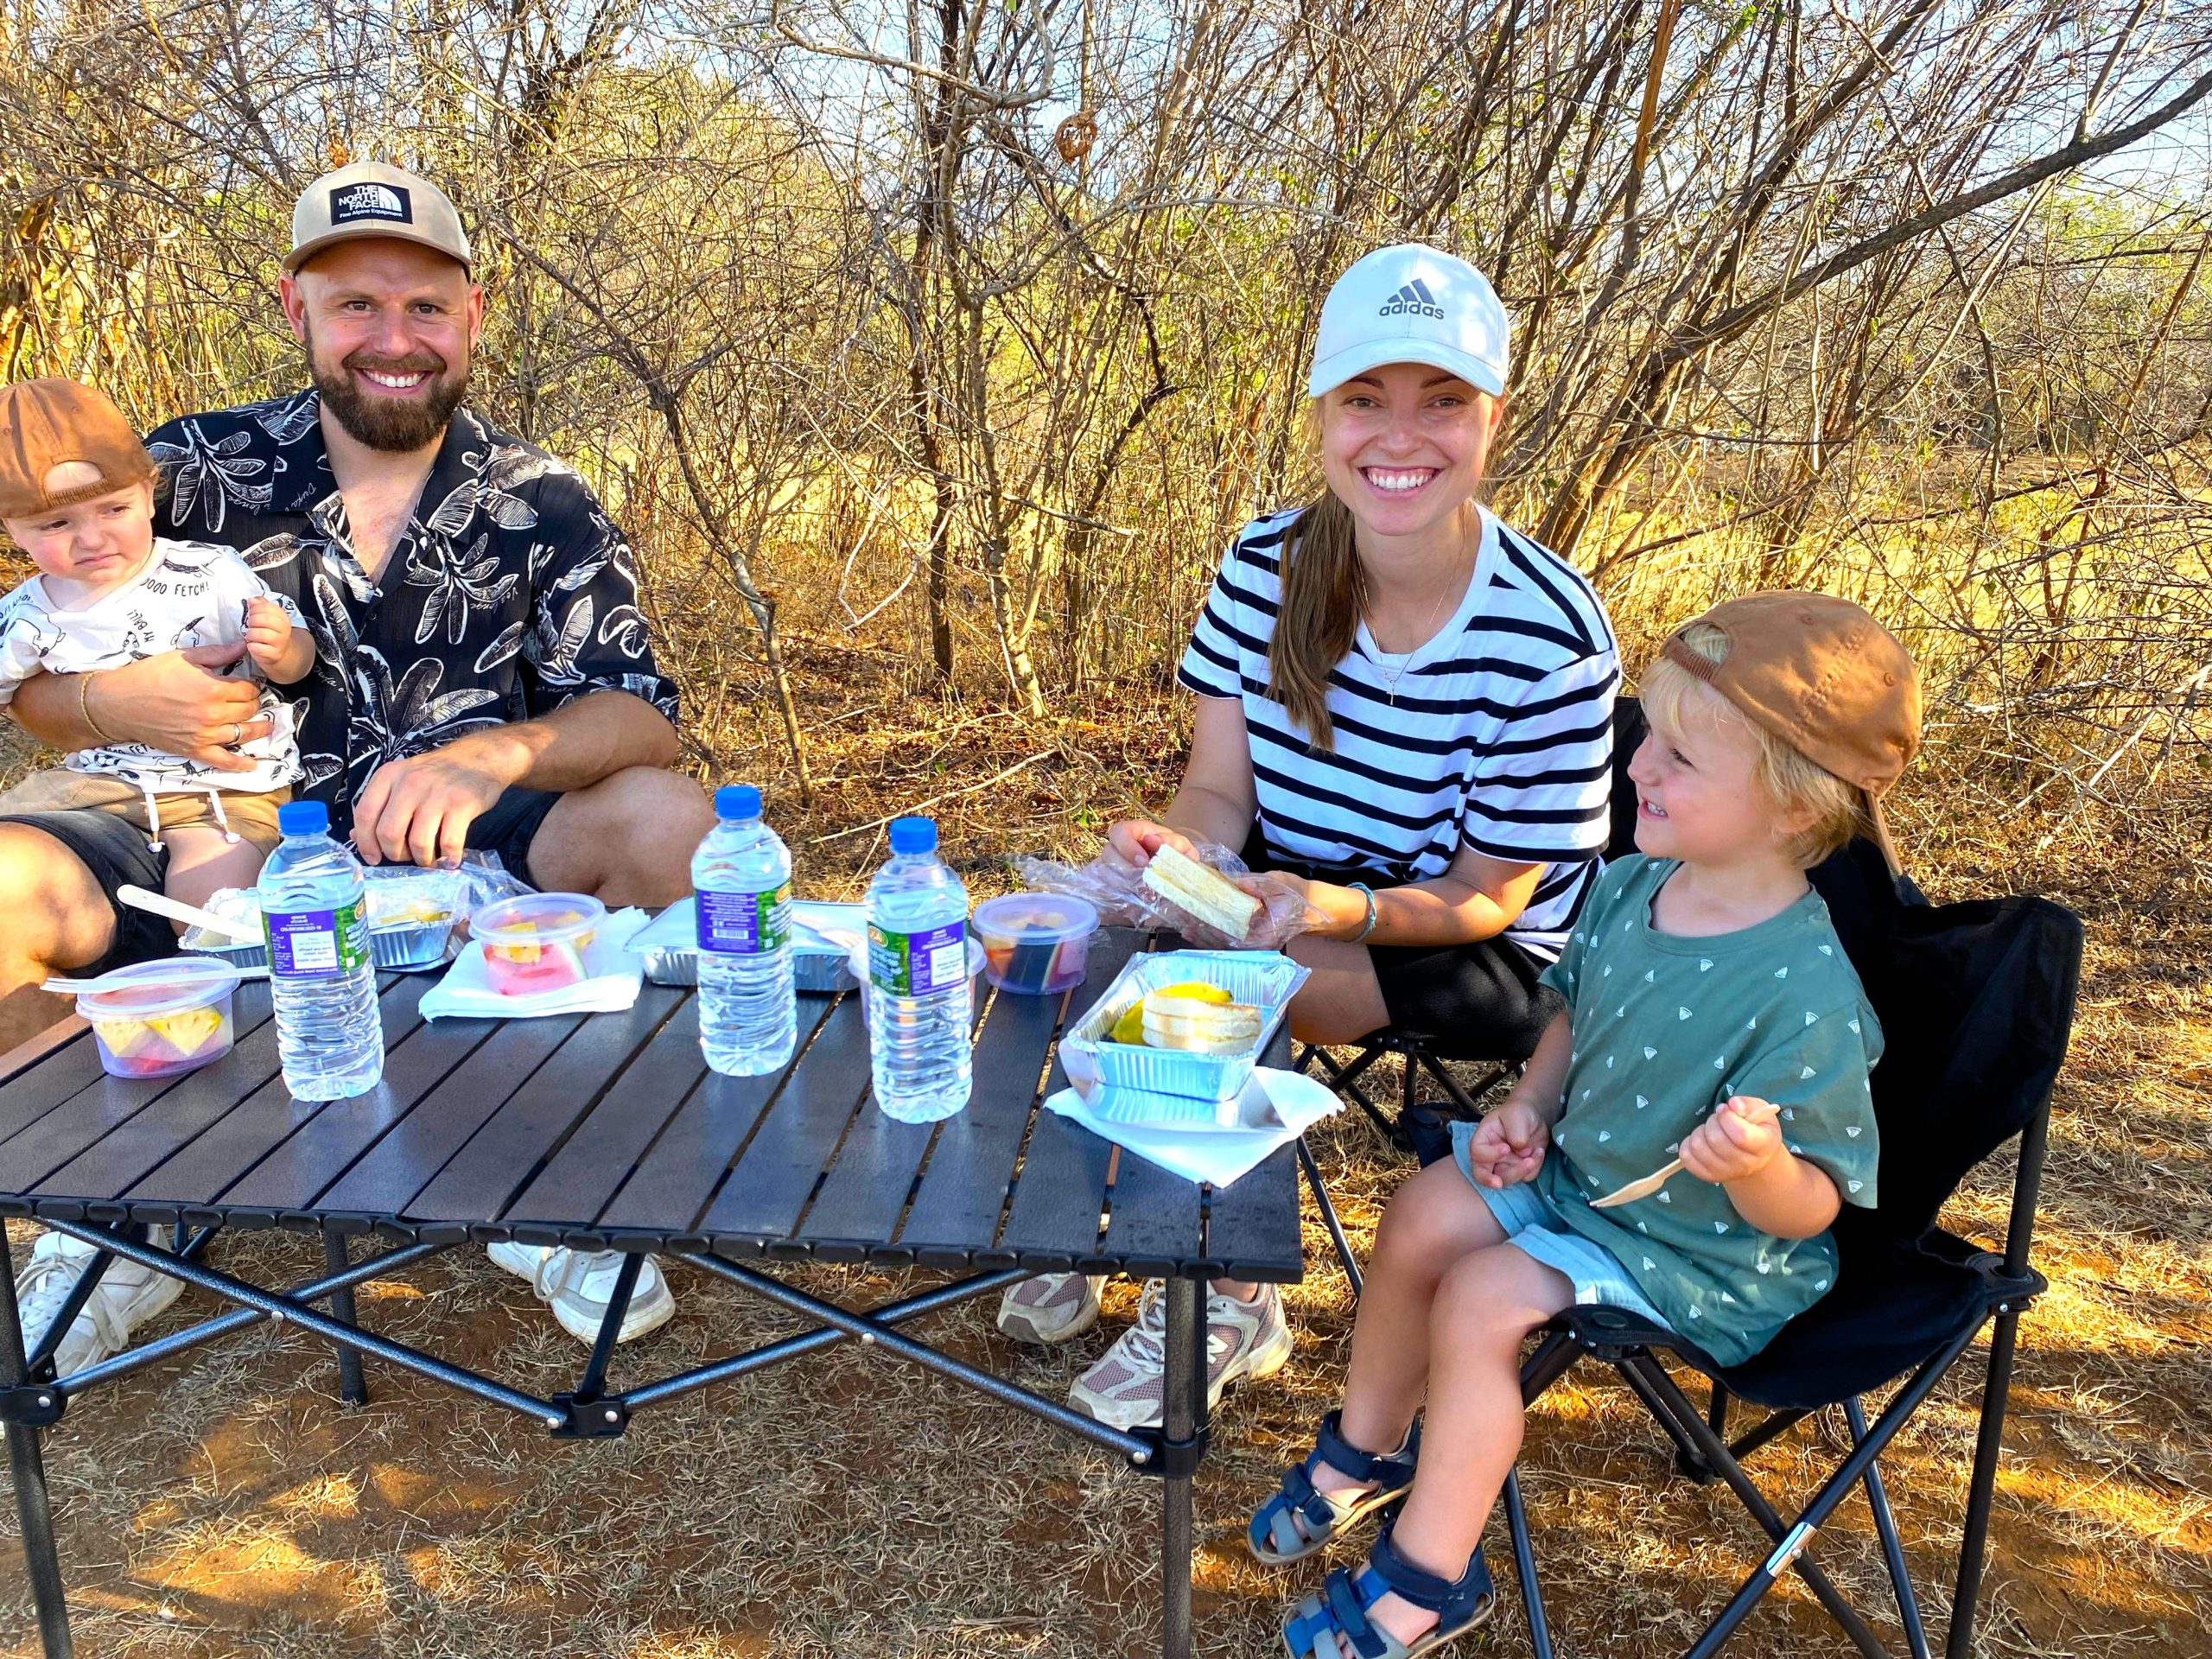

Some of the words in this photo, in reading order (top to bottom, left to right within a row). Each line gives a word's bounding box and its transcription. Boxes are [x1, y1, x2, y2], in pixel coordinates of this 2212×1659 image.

[354, 185, 378, 194] THE
[338, 191, 378, 207] NORTH
[349, 200, 379, 210] FACE
[371, 209, 403, 218] Equipment
[1379, 300, 1445, 320] adidas
[175, 582, 209, 596] FETCH!
[126, 609, 148, 631] BALL!
[143, 632, 155, 643] MY
